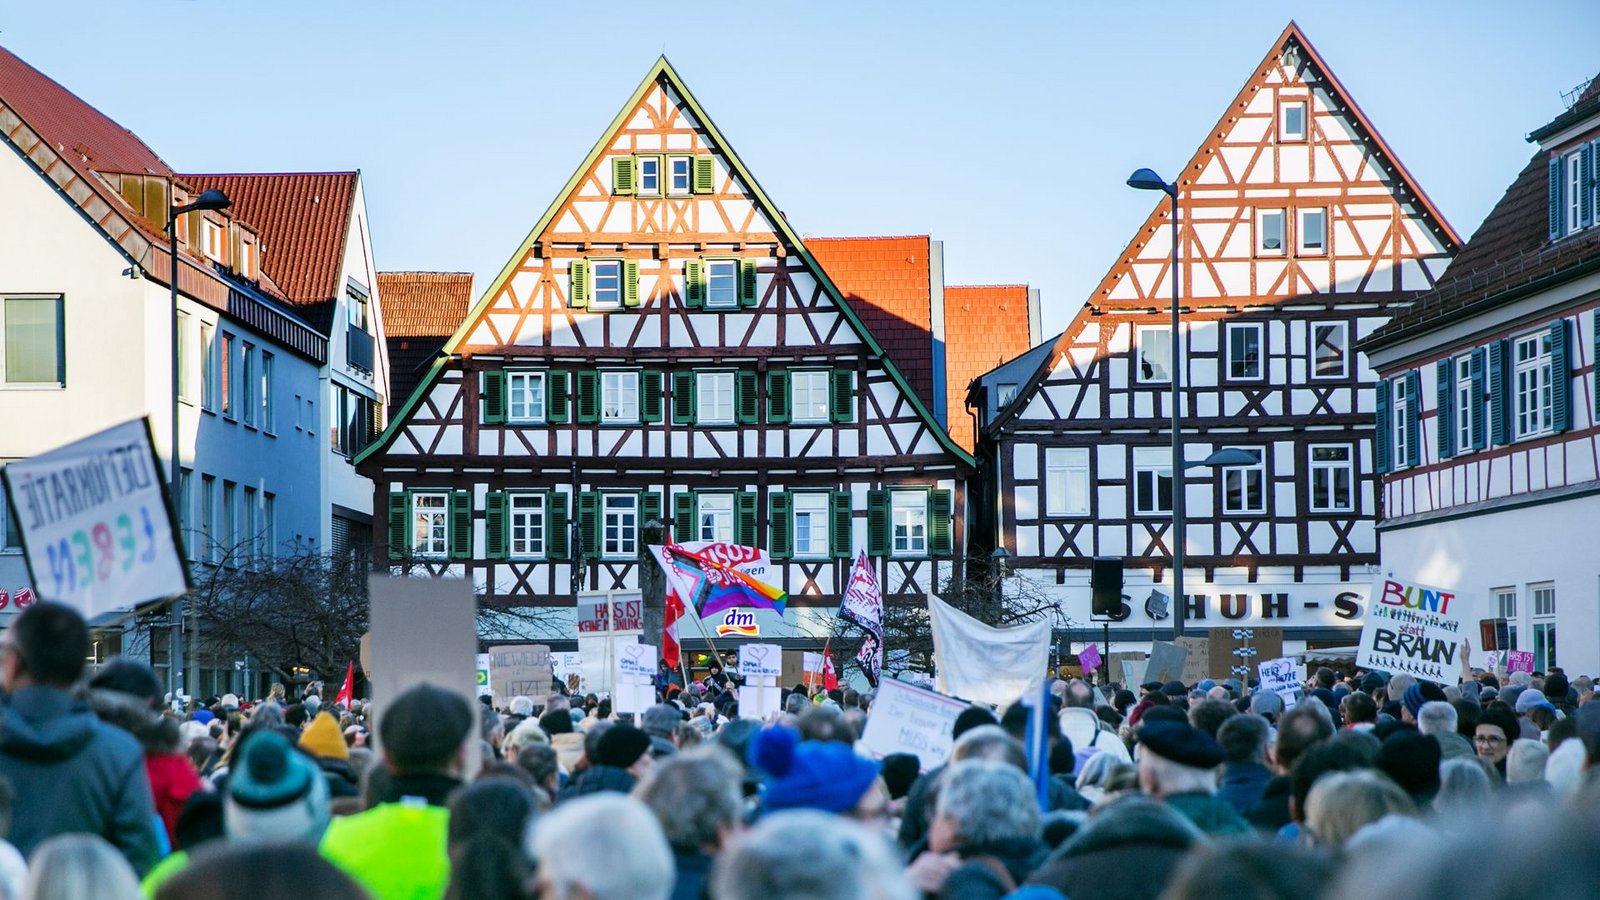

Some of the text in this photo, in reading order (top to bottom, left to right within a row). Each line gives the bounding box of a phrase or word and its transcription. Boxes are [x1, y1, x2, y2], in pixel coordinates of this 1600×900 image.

[1381, 580, 1455, 614] BUNT
[595, 600, 641, 619] HAS IST
[725, 609, 753, 625] dm
[578, 619, 602, 632] KEINE
[1398, 623, 1425, 637] statt
[1373, 628, 1457, 665] BRAUN
